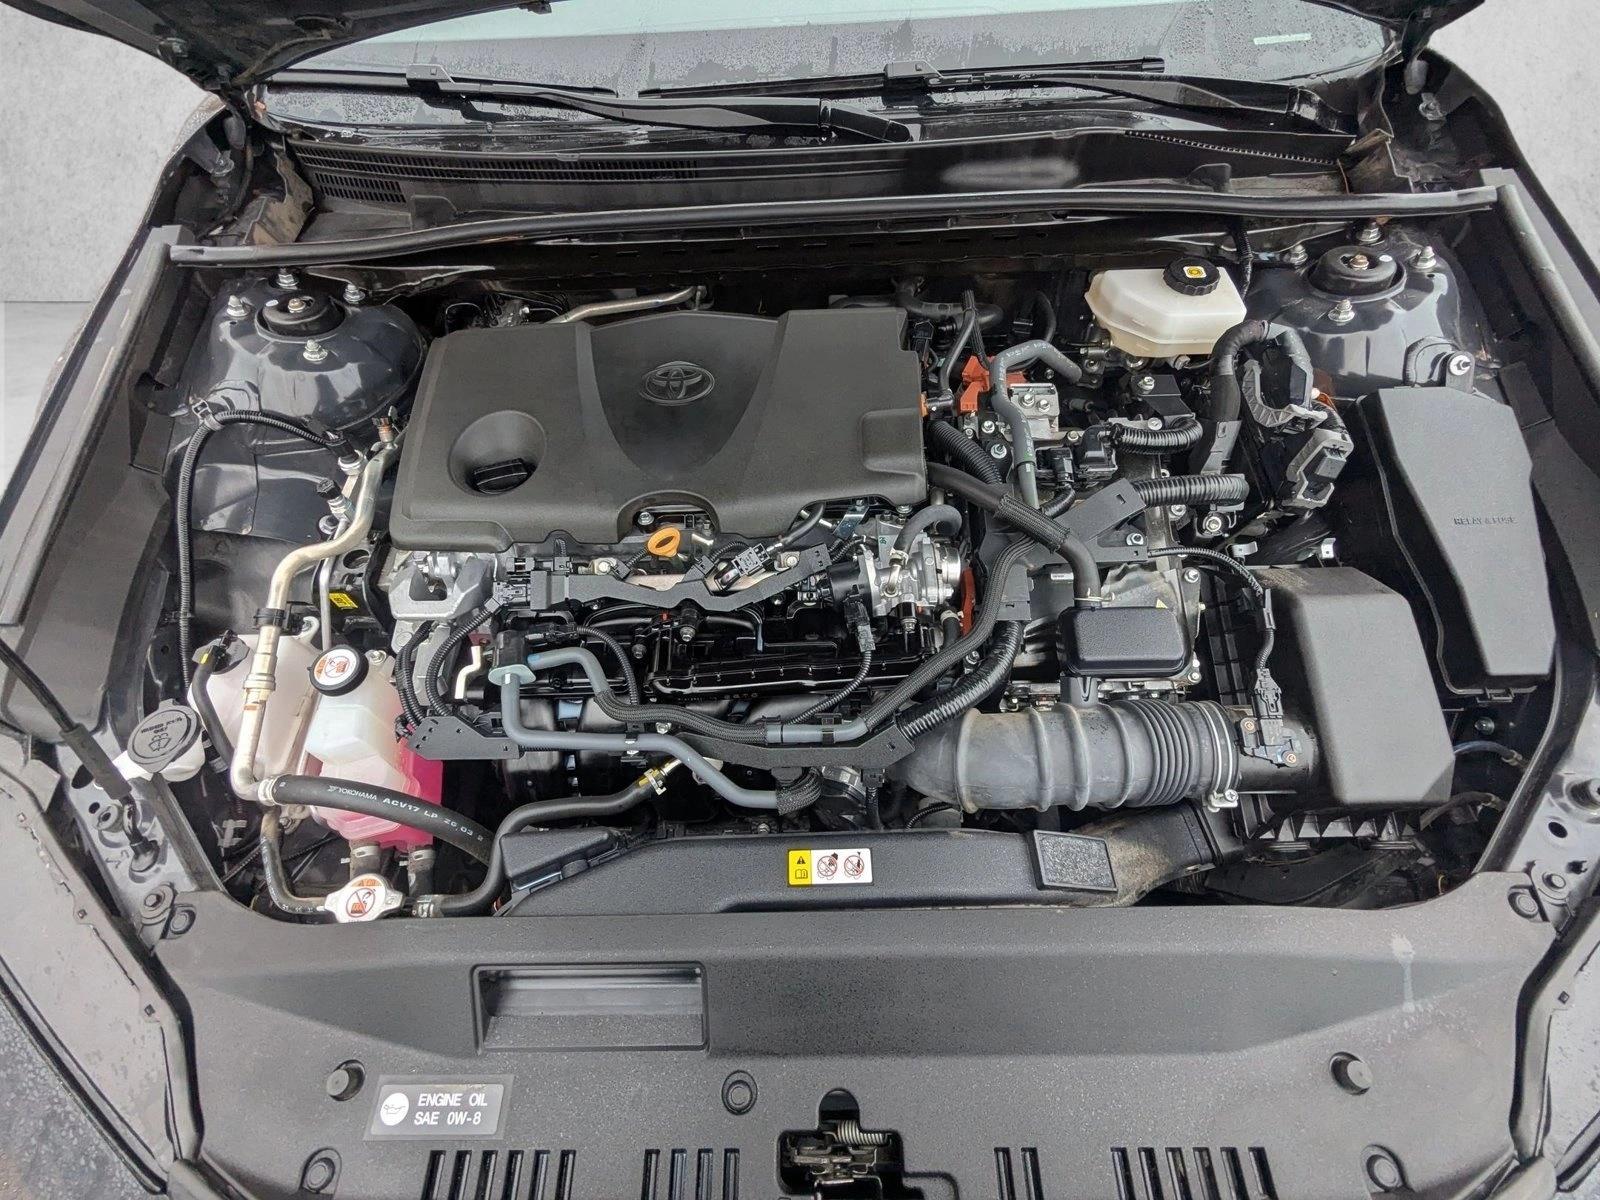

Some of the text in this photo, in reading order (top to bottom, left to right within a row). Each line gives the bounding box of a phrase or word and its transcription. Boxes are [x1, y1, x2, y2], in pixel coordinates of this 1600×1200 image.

[1453, 516, 1482, 526] RELAY
[337, 786, 378, 801] YOKOHAMA
[382, 797, 421, 812] ACV17
[423, 809, 439, 819] LP
[418, 1092, 488, 1107] ENGINE OIL
[414, 1111, 482, 1126] SAE 0W-8
